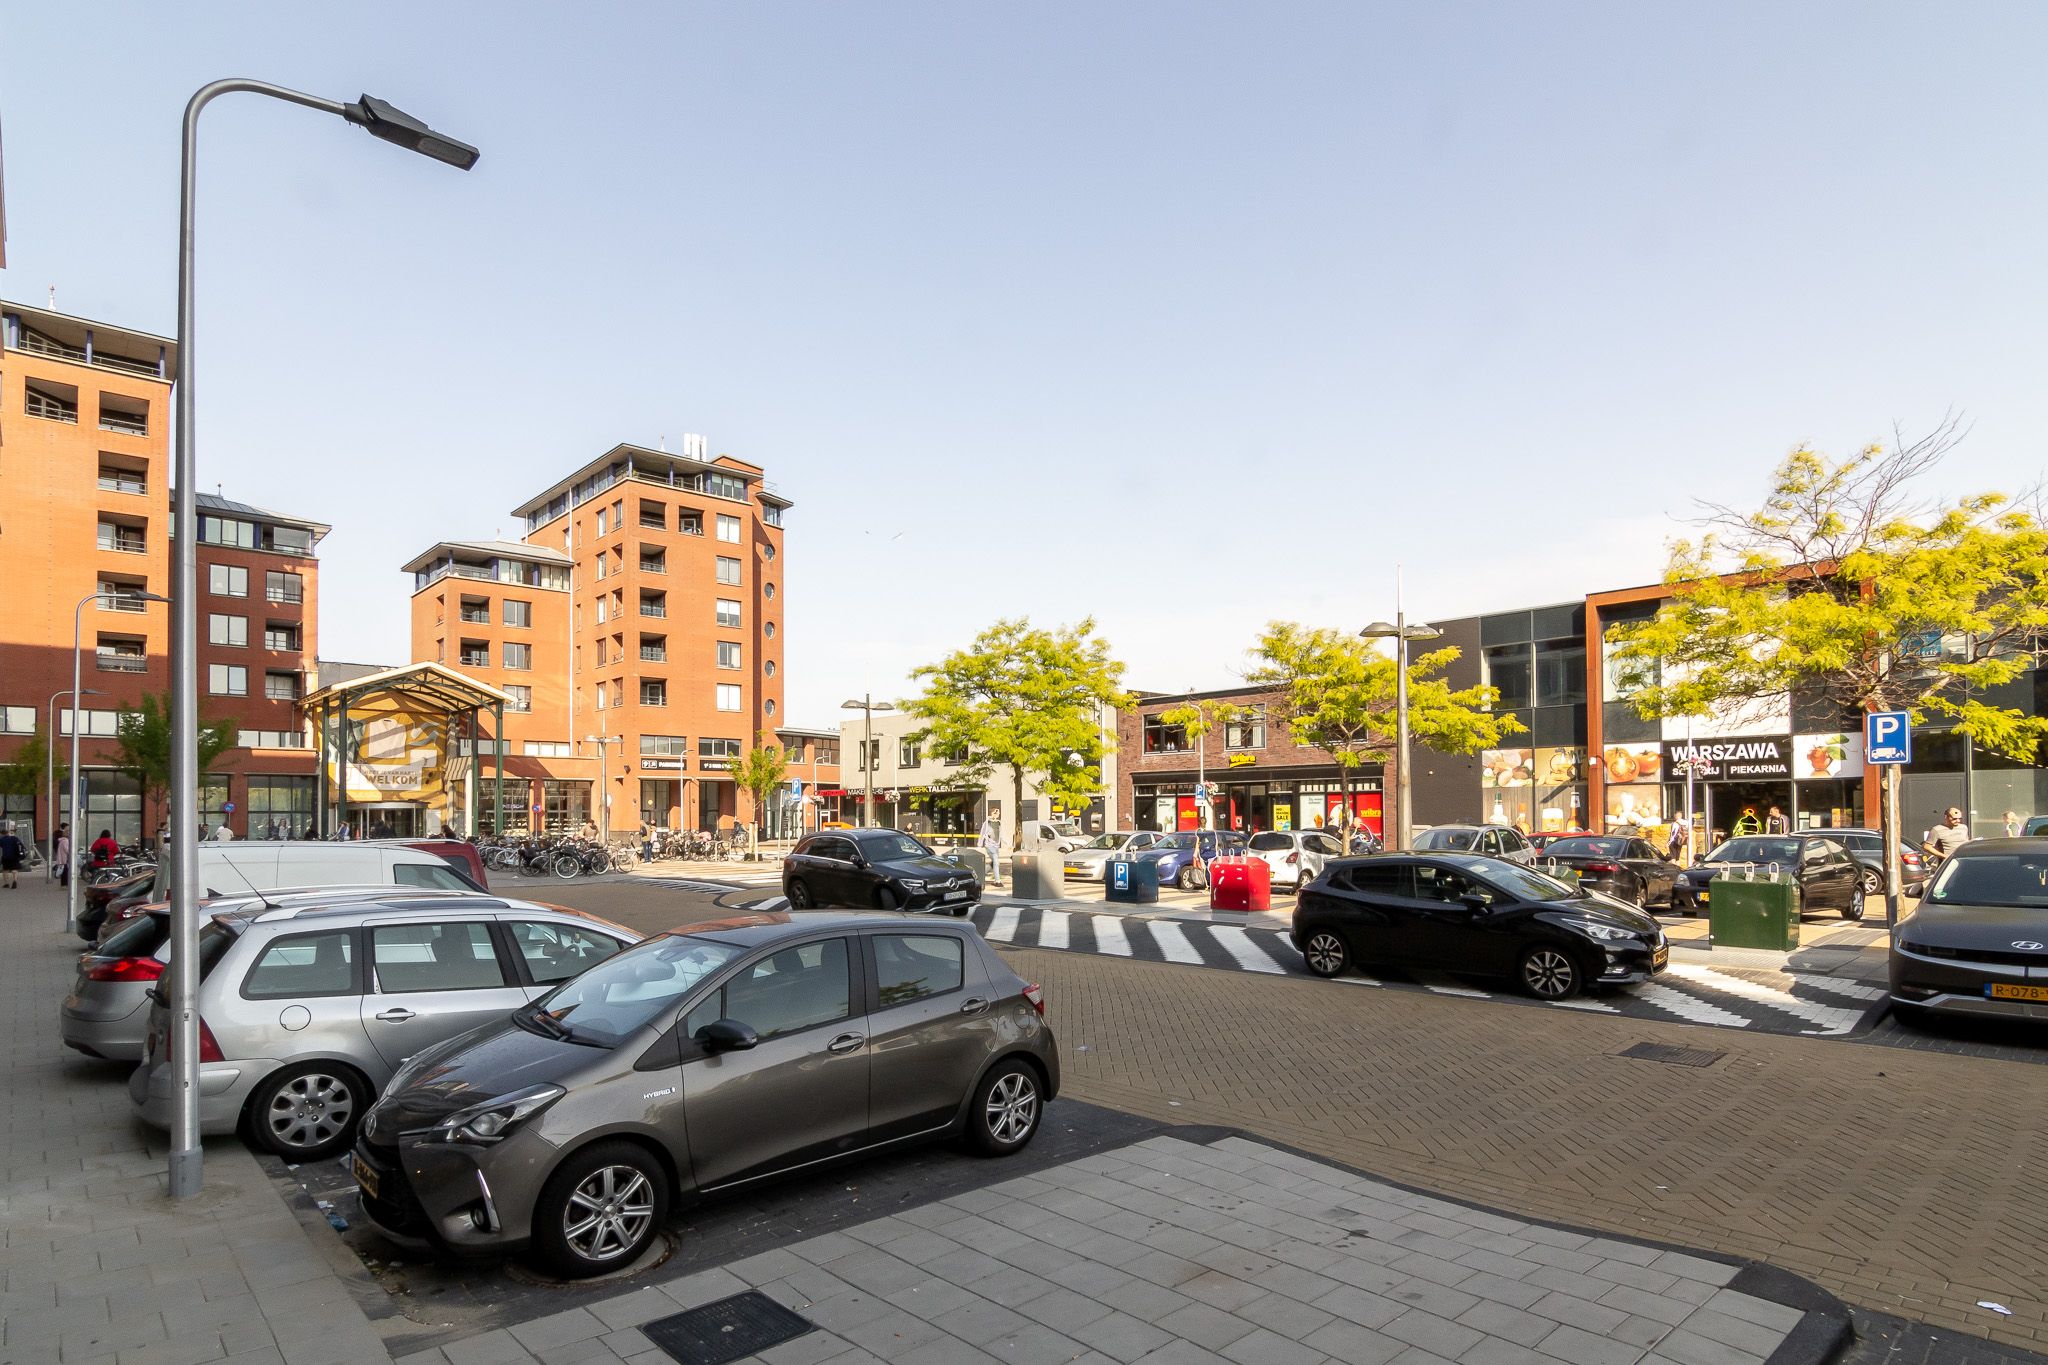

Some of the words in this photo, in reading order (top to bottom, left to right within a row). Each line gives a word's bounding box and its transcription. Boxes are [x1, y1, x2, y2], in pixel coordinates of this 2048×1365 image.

[1877, 716, 1899, 744] P
[1671, 742, 1779, 762] WARSZAWA
[1730, 764, 1787, 775] PIEKARNIA
[365, 775, 417, 785] WELKOM
[1117, 865, 1125, 879] P
[643, 1088, 671, 1099] HYBRID
